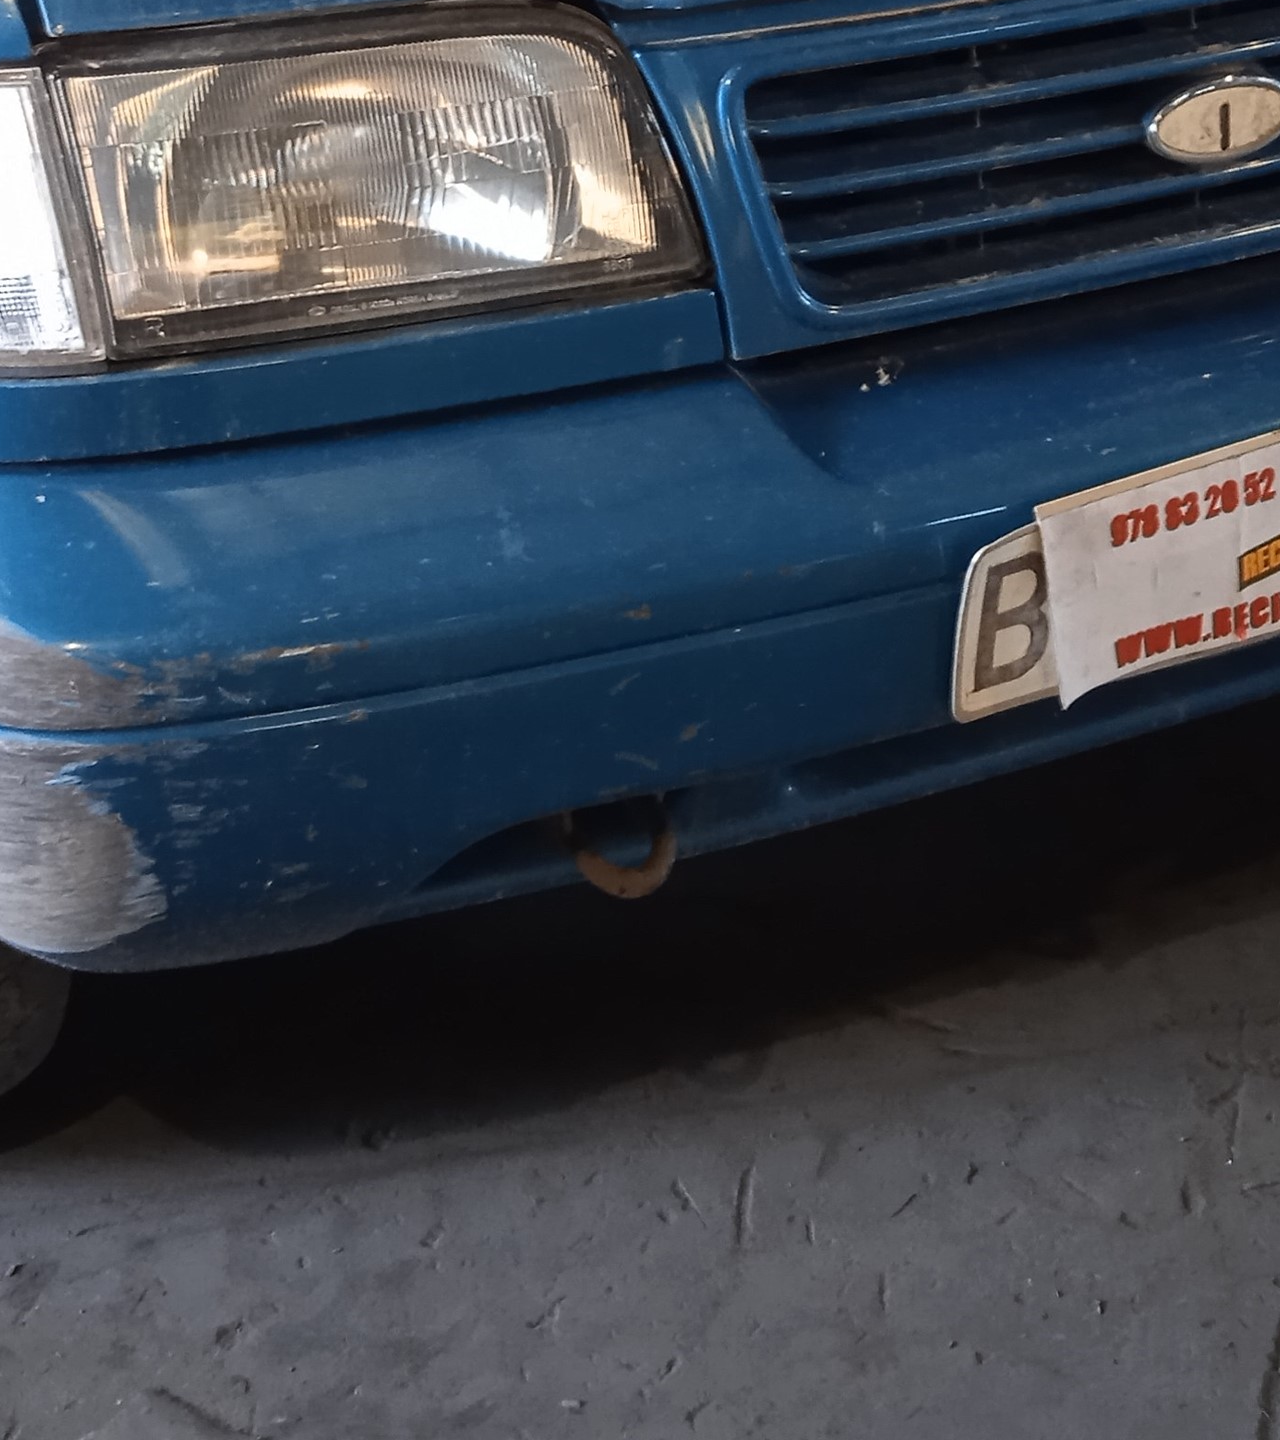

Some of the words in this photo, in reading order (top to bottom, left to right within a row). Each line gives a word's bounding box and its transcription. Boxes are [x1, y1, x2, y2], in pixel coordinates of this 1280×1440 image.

[1110, 504, 1160, 547] 978
[1165, 491, 1200, 531] 83
[1205, 479, 1239, 520] 20
[1244, 467, 1277, 507] 52
[974, 550, 1050, 694] B
